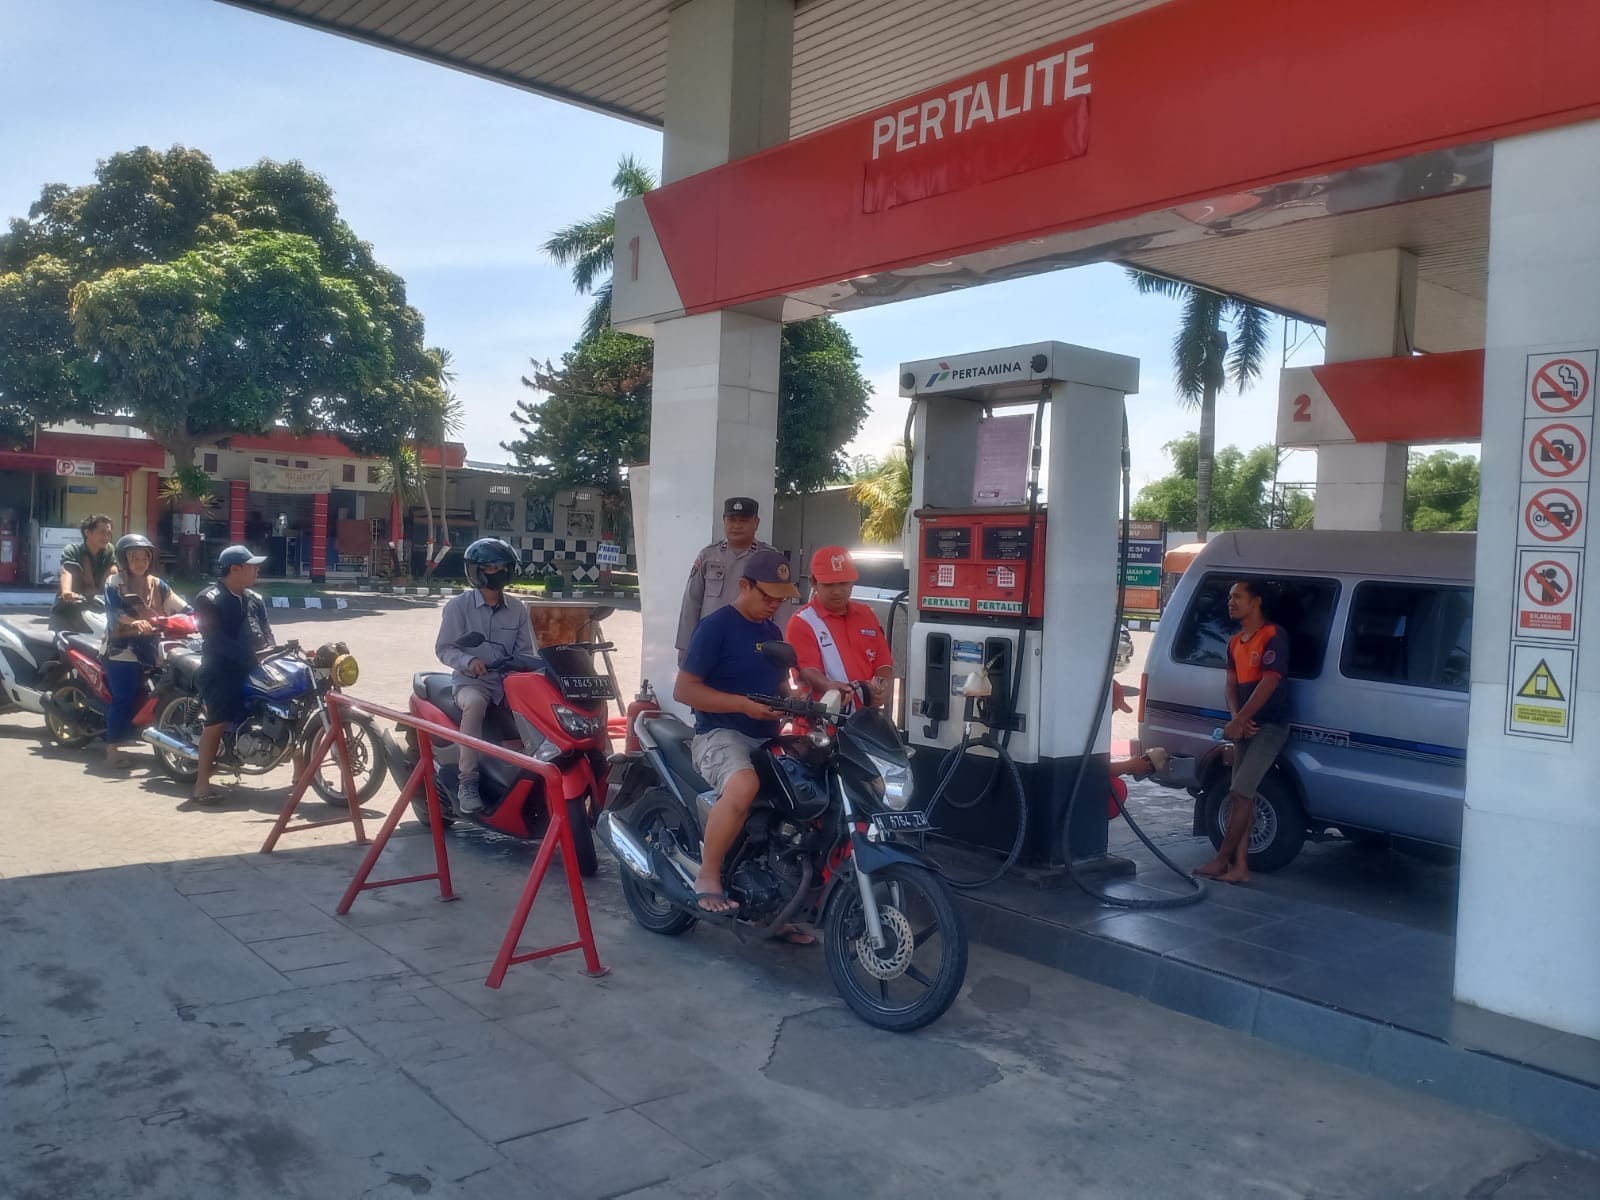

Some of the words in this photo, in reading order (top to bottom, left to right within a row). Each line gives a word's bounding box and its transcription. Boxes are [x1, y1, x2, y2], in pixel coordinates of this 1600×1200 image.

[872, 42, 1094, 160] PERTALITE
[629, 235, 640, 282] 1
[952, 361, 1022, 380] PERTAMINA
[1293, 393, 1312, 423] 2
[922, 597, 970, 608] PERTALITE
[977, 600, 1026, 612] PERTALIT
